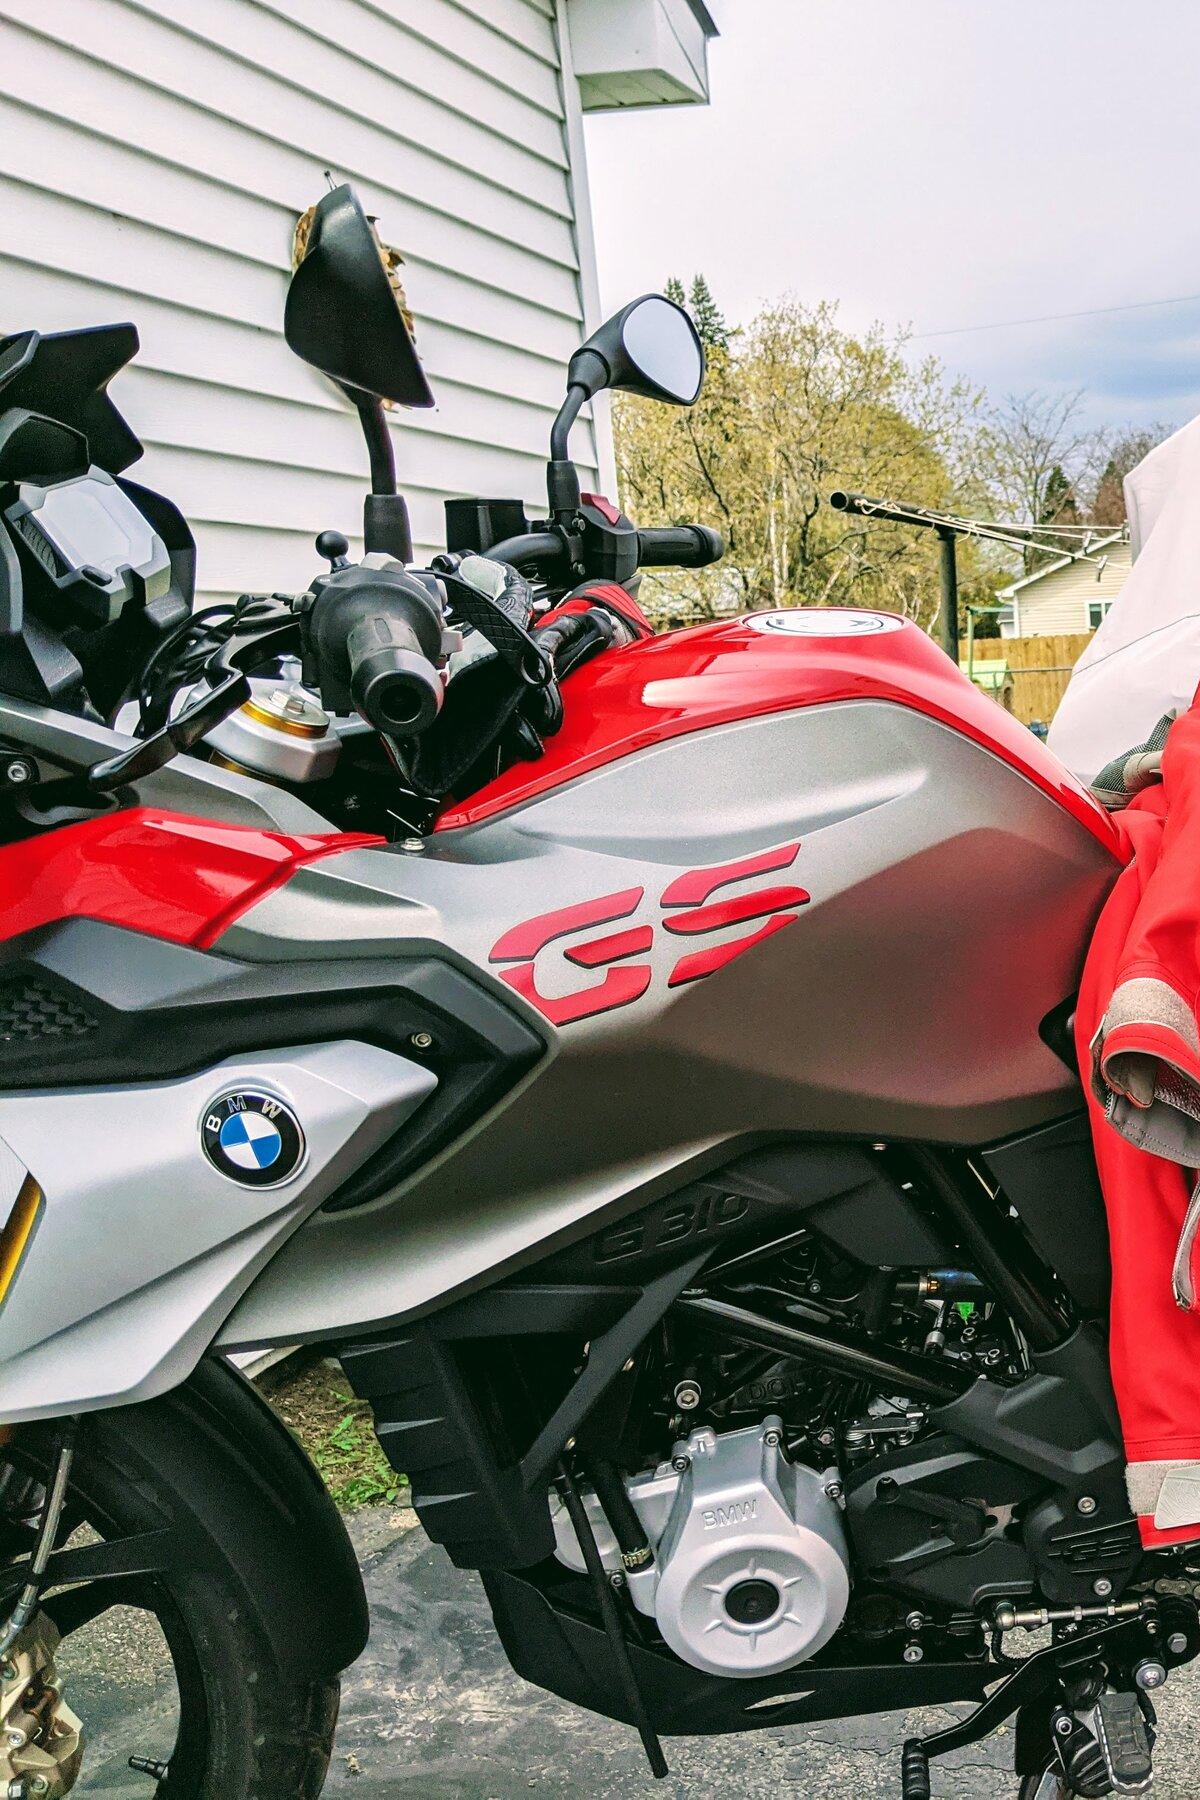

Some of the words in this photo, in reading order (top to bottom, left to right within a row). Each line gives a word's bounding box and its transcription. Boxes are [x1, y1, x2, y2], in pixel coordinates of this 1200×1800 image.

[489, 842, 811, 1028] GS
[205, 1094, 283, 1133] BMW
[654, 1190, 752, 1249] 310
[701, 1498, 758, 1531] BMW
